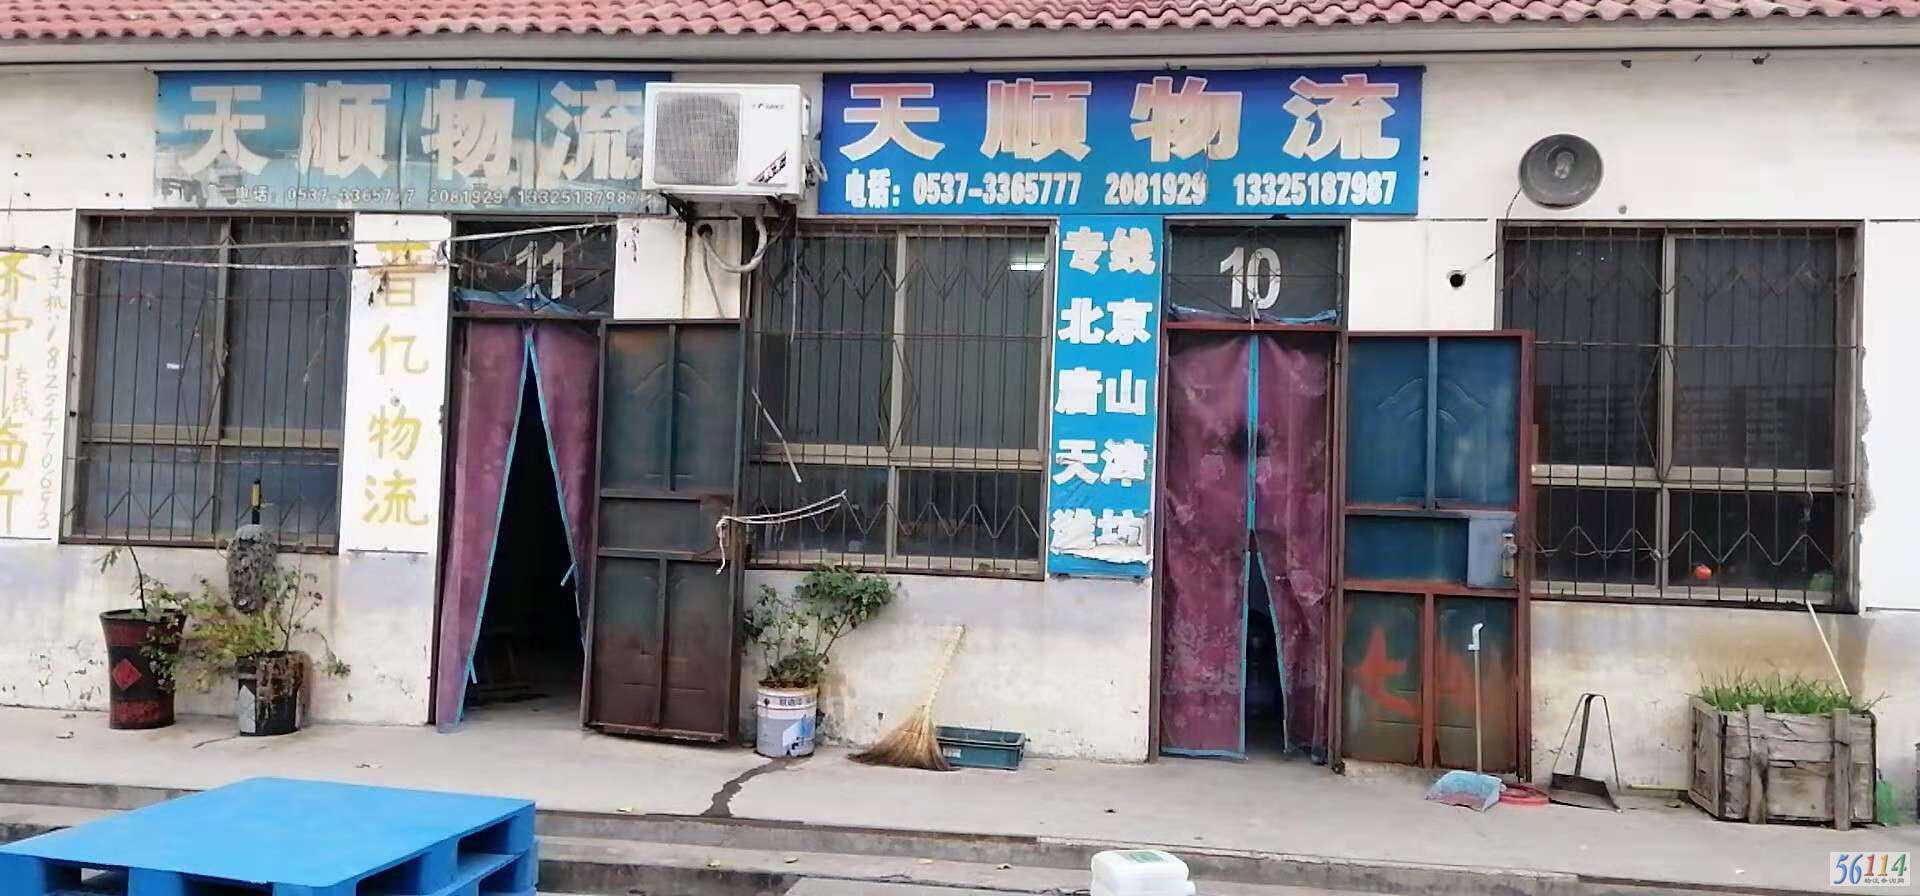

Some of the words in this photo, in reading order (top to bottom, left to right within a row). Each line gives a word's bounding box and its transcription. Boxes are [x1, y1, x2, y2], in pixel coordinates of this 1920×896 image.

[179, 79, 644, 180] 天顺物流
[840, 74, 1401, 163] 天顺物流
[287, 186, 417, 203] 0537-336577
[912, 171, 1083, 206] 0537-3365777
[1104, 171, 1208, 206] 2081929
[1233, 171, 1398, 206] 13325187987
[515, 240, 564, 299] 11
[1062, 226, 1156, 275] 专线
[1220, 247, 1281, 310] 10
[1058, 297, 1153, 345] 北京
[1055, 366, 1147, 415] 唐山
[1053, 438, 1148, 487] 天津
